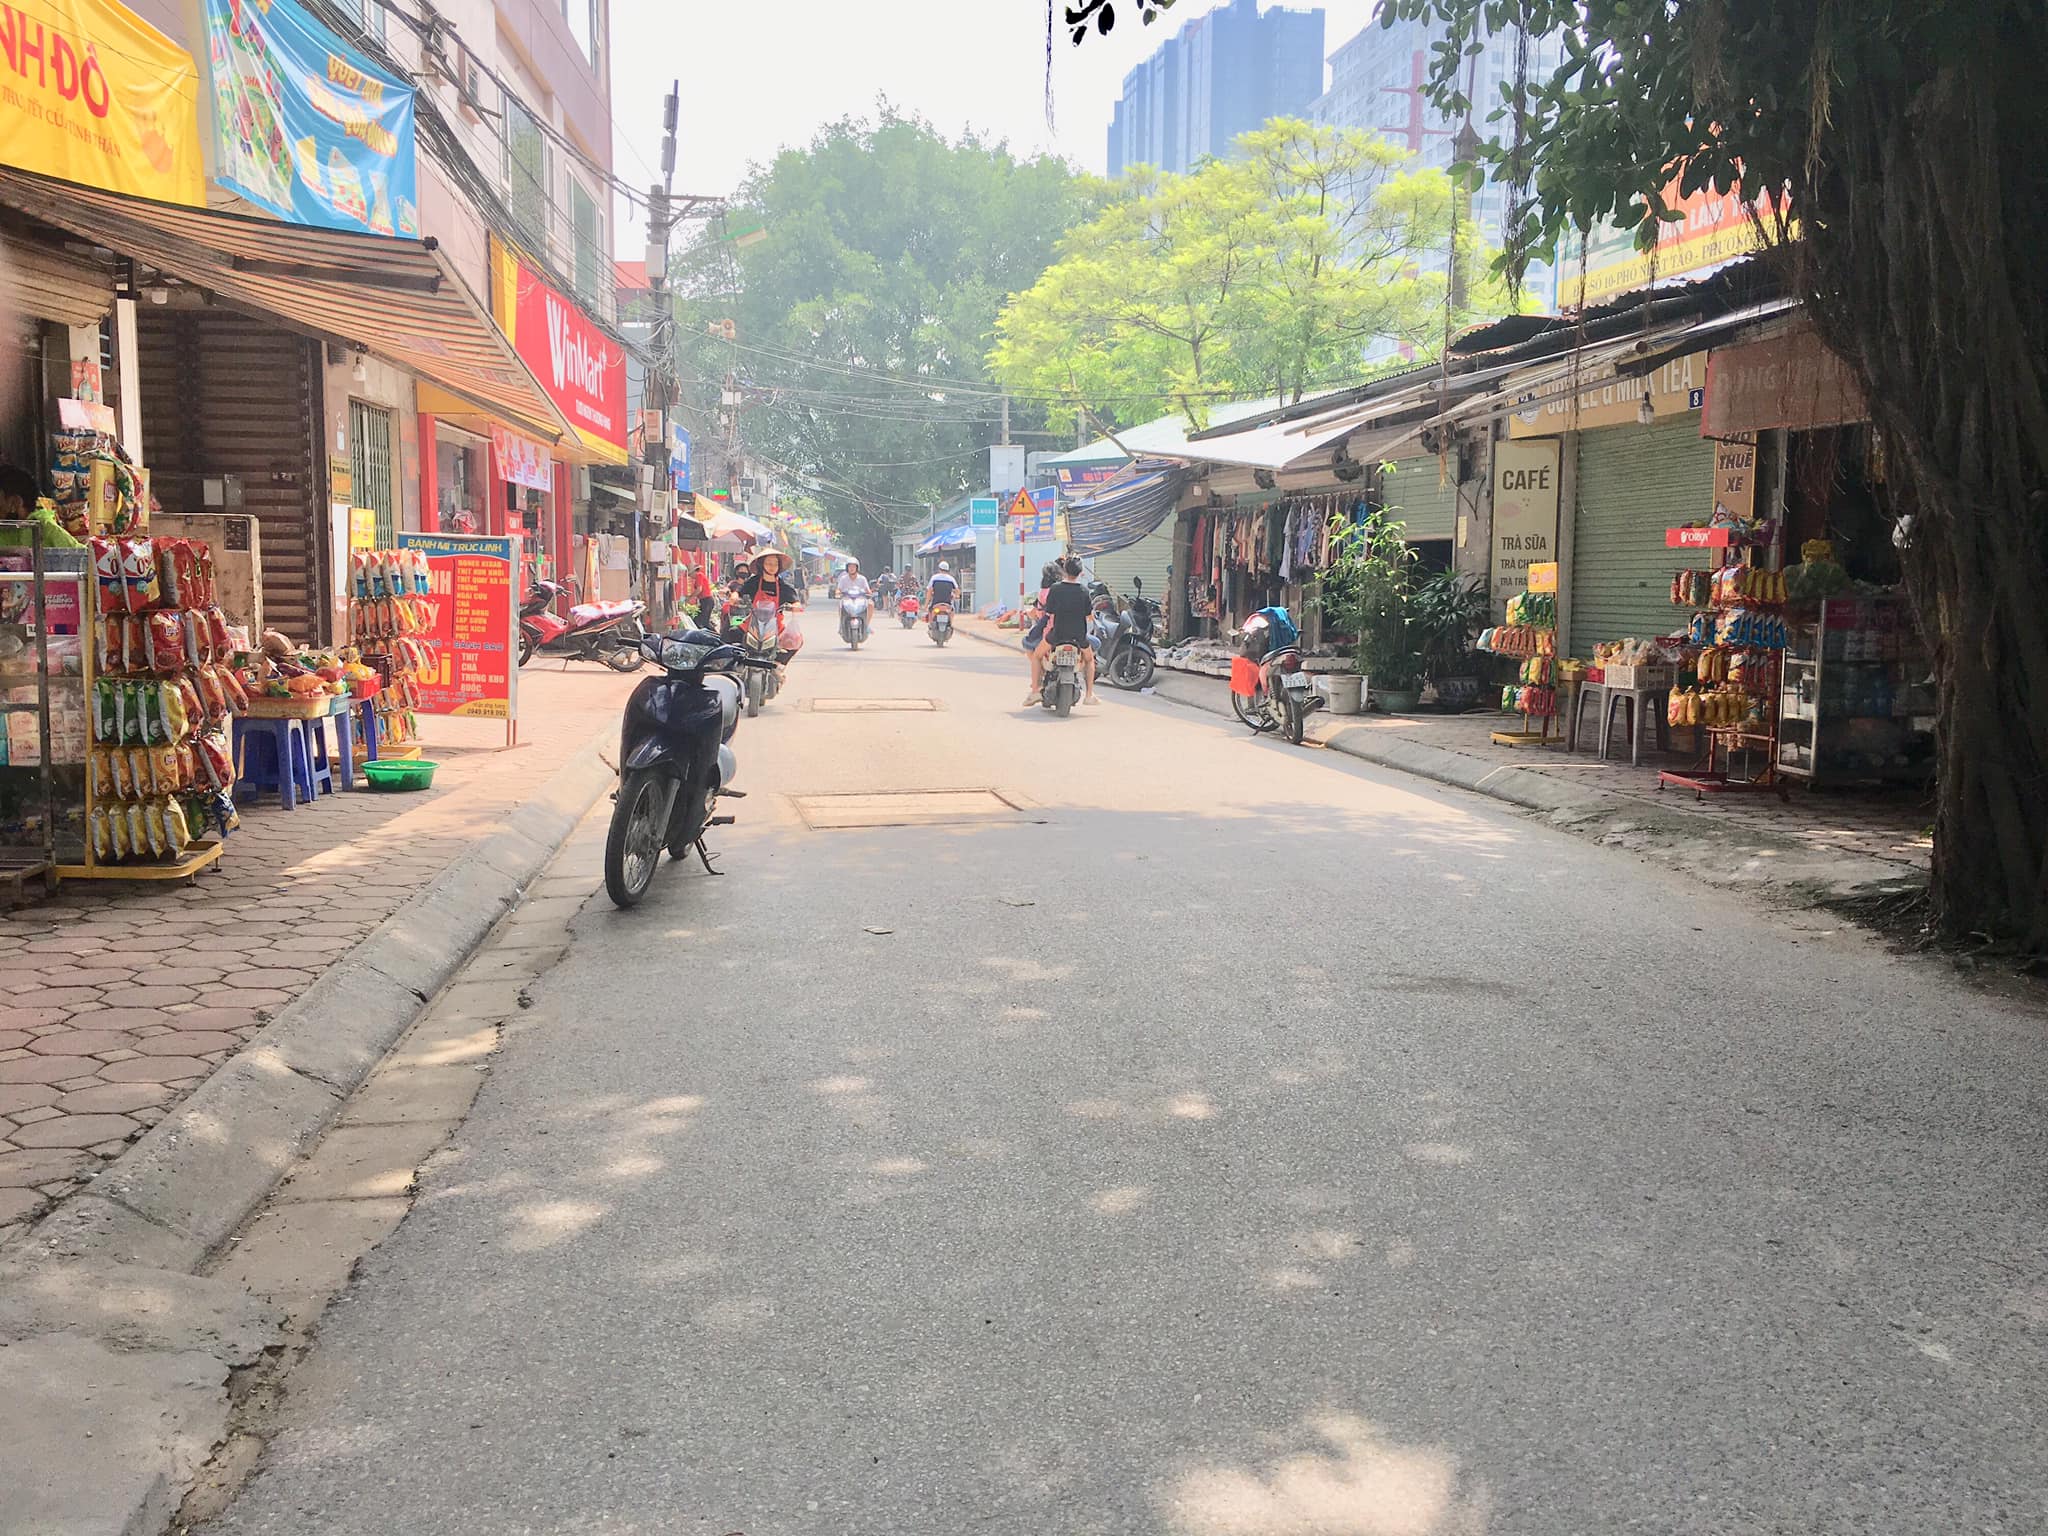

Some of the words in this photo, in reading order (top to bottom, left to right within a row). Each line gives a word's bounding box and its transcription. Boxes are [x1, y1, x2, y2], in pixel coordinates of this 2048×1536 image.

[1662, 354, 1693, 394] TEA
[1692, 391, 1700, 406] 8
[1720, 450, 1753, 470] THUÊ
[1502, 465, 1550, 490] CAFÉ
[1726, 476, 1744, 493] XE
[1501, 535, 1522, 551] TRÀ
[1524, 533, 1547, 551] SỮA
